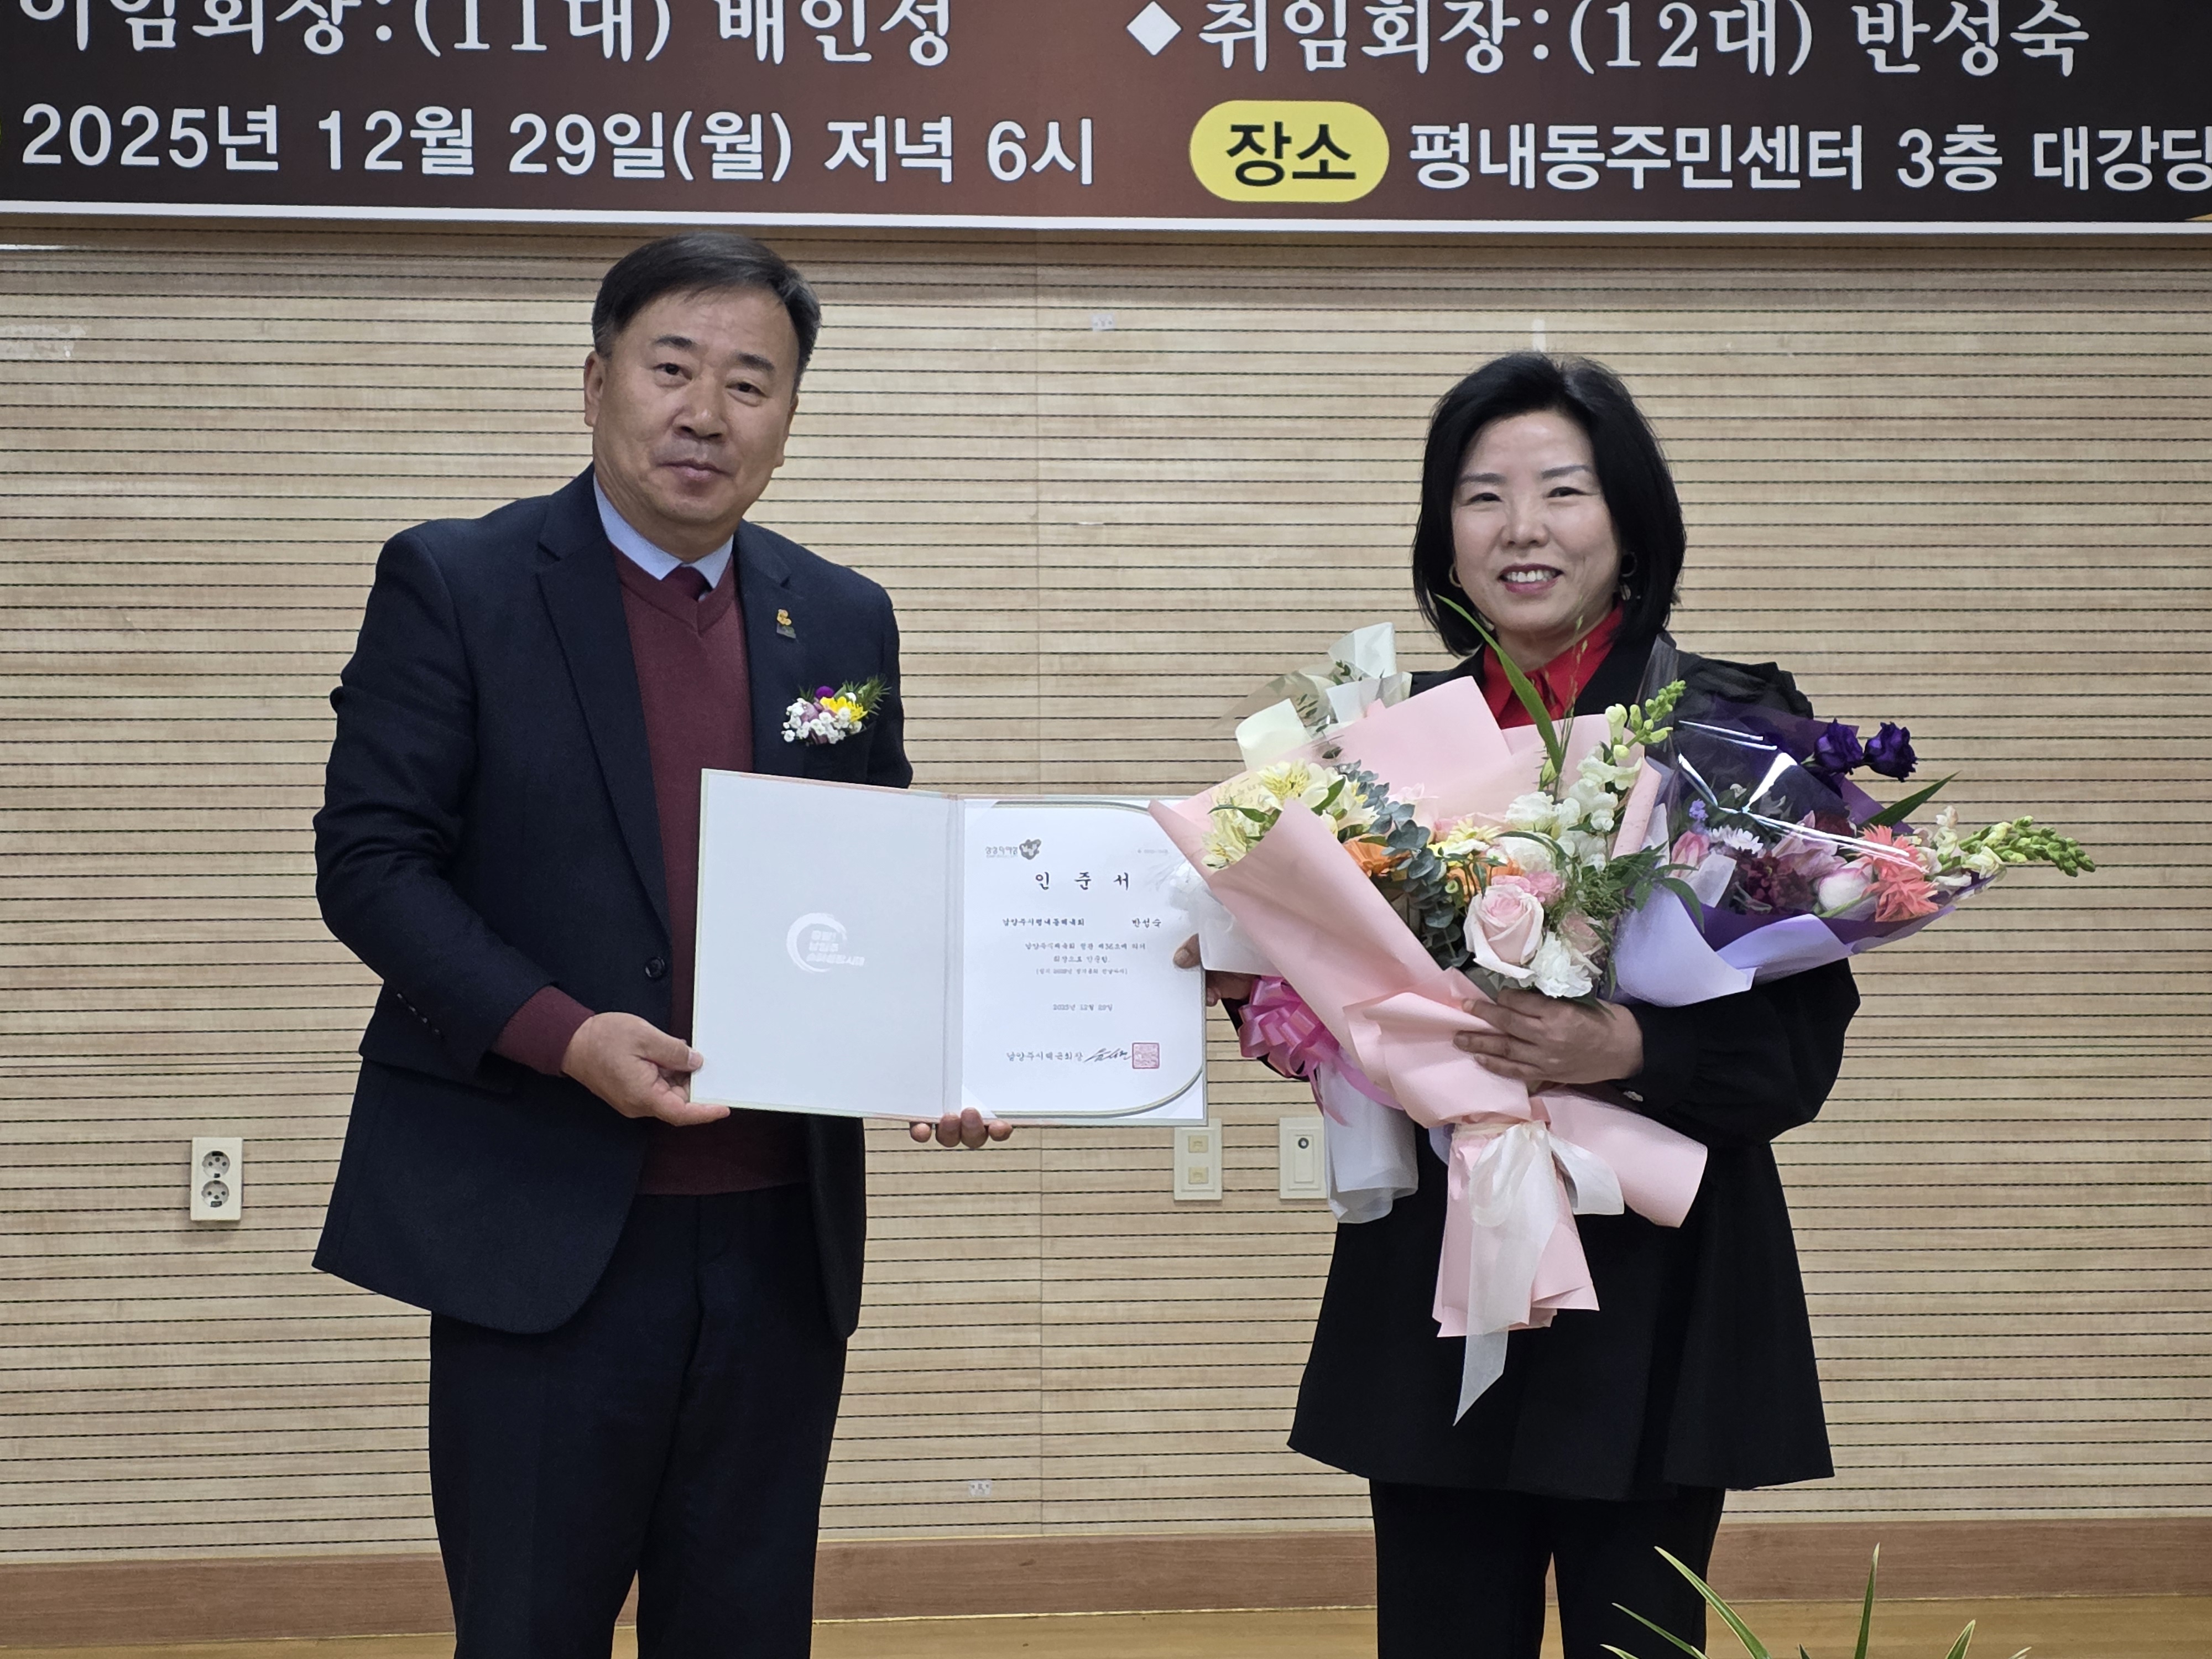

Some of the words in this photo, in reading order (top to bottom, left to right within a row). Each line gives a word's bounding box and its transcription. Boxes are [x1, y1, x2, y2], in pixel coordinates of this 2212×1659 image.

[713, 0, 950, 66] 배인성
[1851, 0, 2089, 76] 반성숙
[22, 103, 279, 171] 2025년
[319, 106, 474, 175] 12월
[509, 111, 791, 182] 29일(월)
[824, 116, 952, 183] 저녁
[987, 118, 1093, 185] 6시
[1227, 121, 1356, 187] 장소
[1410, 123, 1863, 190] 평내동주민센터
[1898, 124, 2002, 191] 3층
